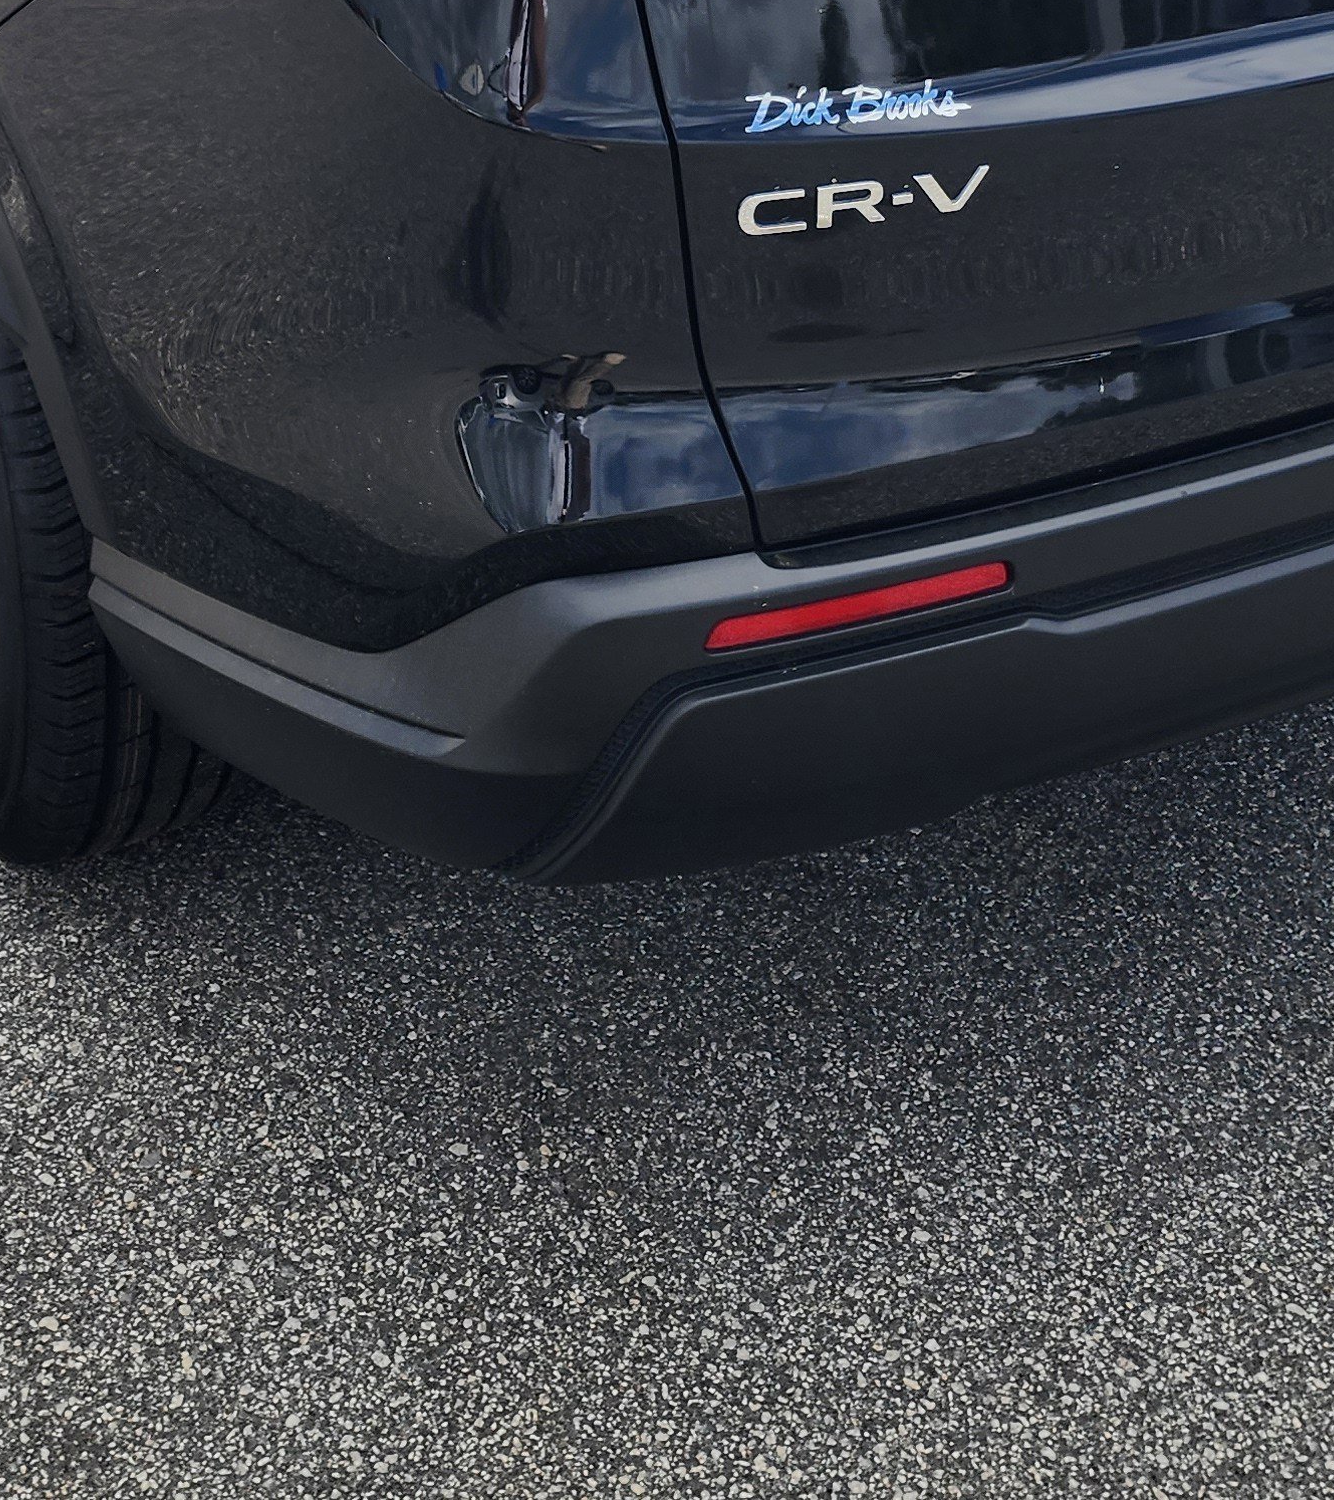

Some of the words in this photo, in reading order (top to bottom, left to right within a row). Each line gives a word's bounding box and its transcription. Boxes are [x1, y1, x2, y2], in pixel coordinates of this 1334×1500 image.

[745, 85, 840, 134] Dick
[841, 78, 972, 124] Brooks
[738, 164, 990, 236] CR-V
